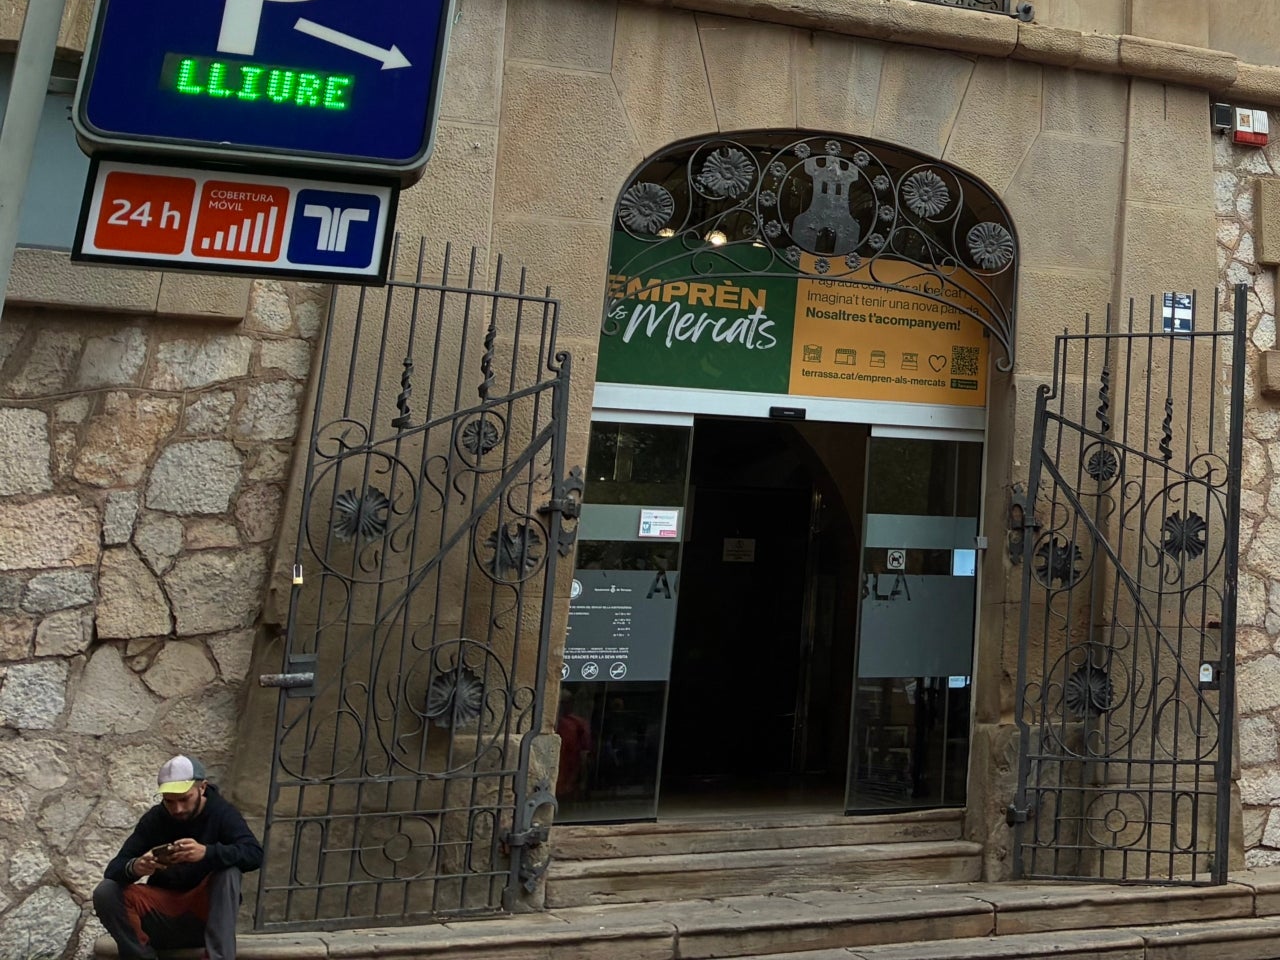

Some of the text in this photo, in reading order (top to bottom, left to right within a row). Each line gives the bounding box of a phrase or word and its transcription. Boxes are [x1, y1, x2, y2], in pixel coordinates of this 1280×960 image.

[177, 59, 350, 110] LLIURE
[208, 200, 244, 212] MÓVIL
[210, 190, 275, 203] COBERTURA
[107, 198, 181, 231] 24 h
[606, 274, 767, 311] EMPRÈN
[807, 290, 860, 306] Imagina't
[861, 296, 887, 308] tenir
[889, 299, 910, 311] una
[912, 302, 939, 313] nova
[622, 301, 777, 350] Mercats
[806, 306, 961, 331] Nosaltres t'acompanyem!
[802, 368, 946, 388] terrassa.cat/empren-als-mercats
